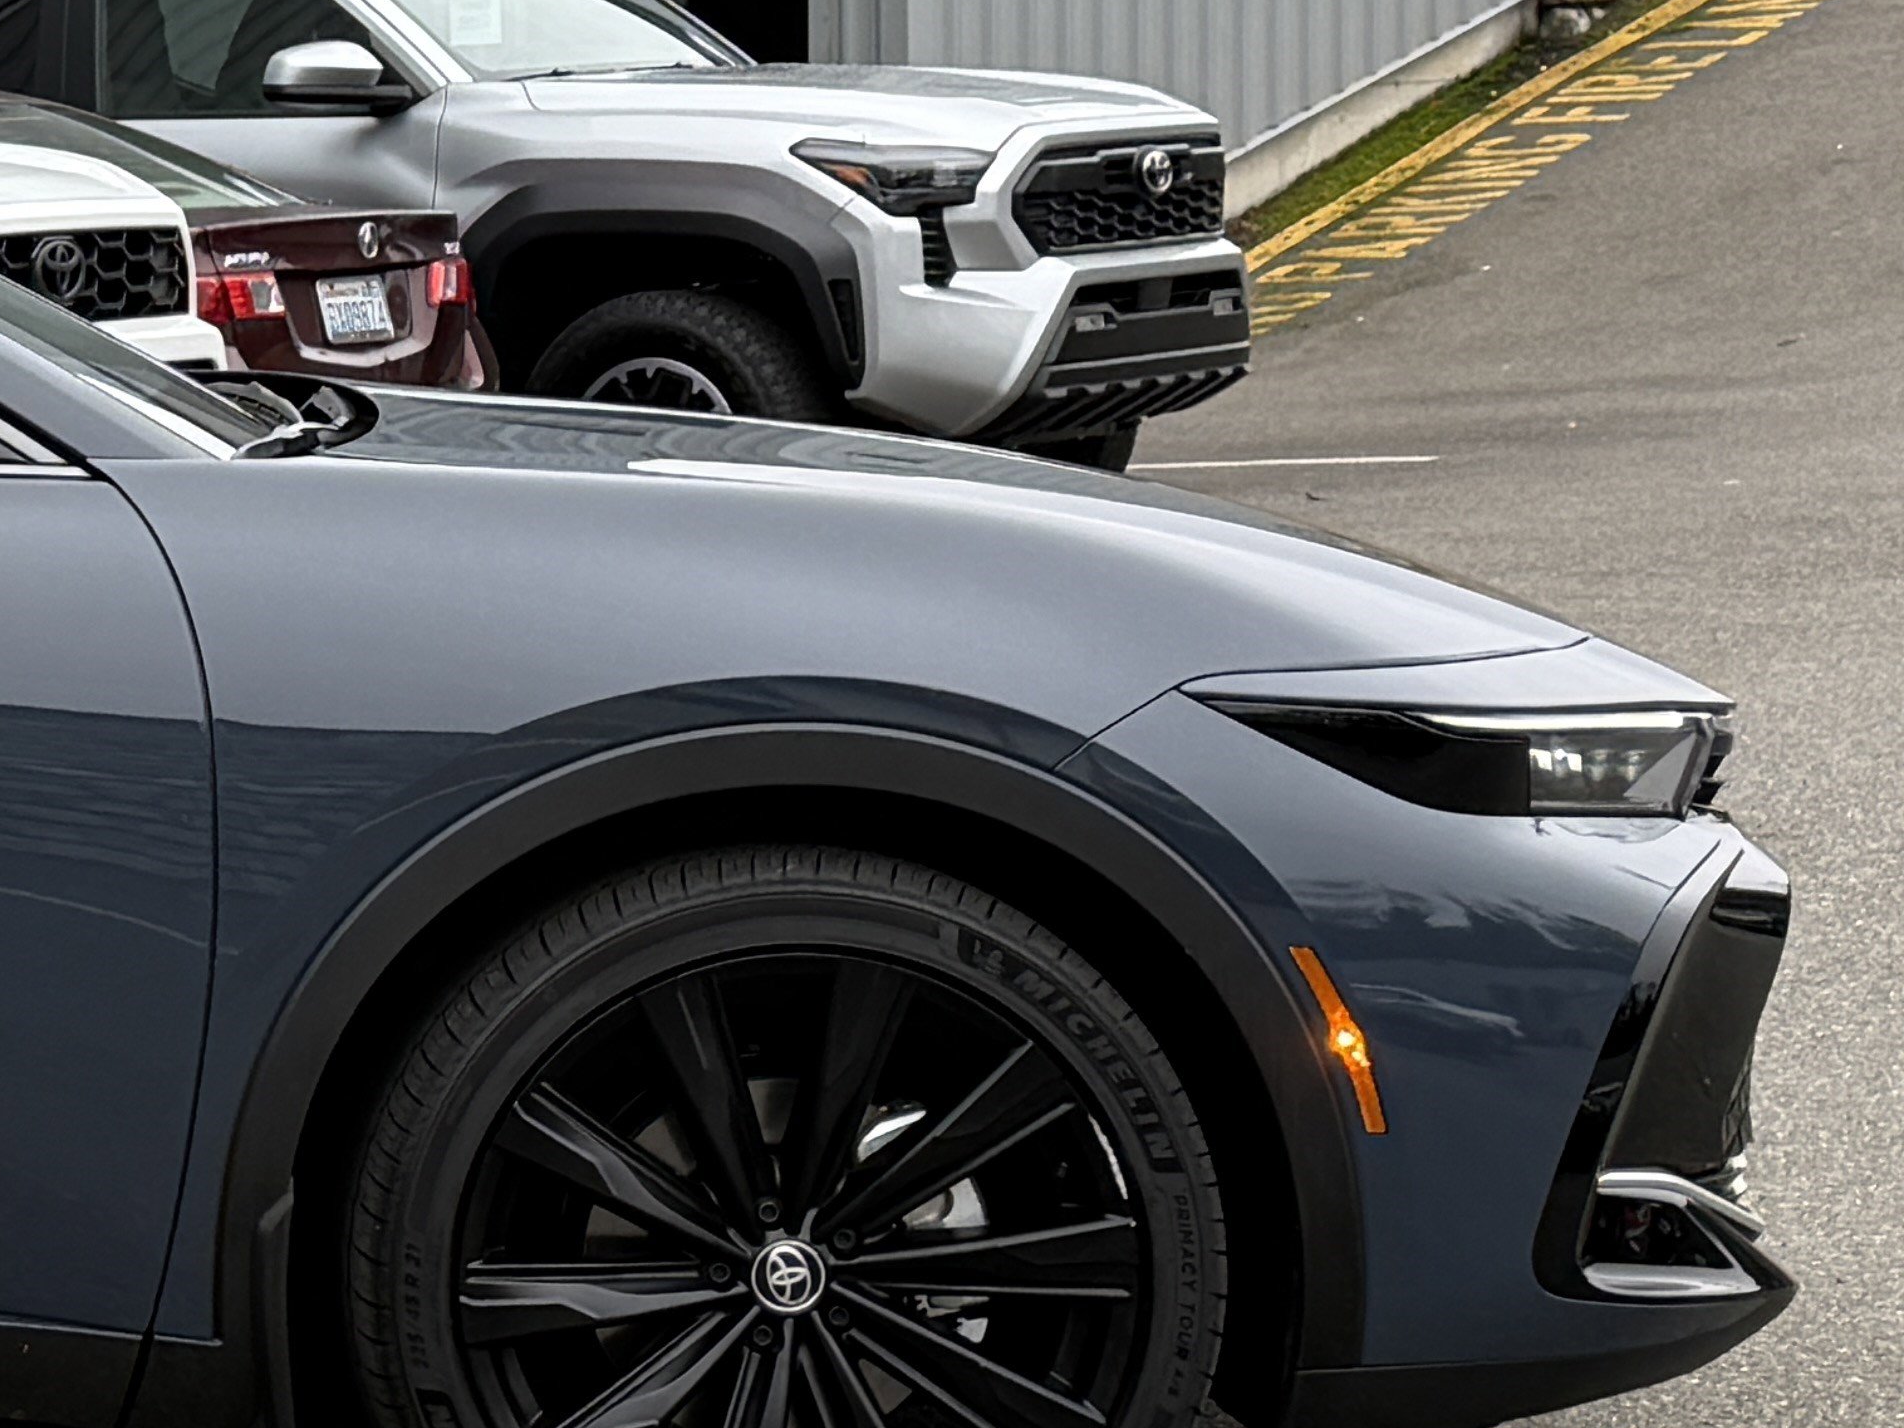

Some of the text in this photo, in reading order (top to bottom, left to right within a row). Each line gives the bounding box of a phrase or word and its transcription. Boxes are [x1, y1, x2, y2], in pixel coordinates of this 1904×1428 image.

[1510, 50, 1729, 127] FIRE
[1012, 968, 1178, 1160] MICHELIN
[1172, 1192, 1200, 1293] PRIMACY
[1173, 1301, 1197, 1363] TOUR
